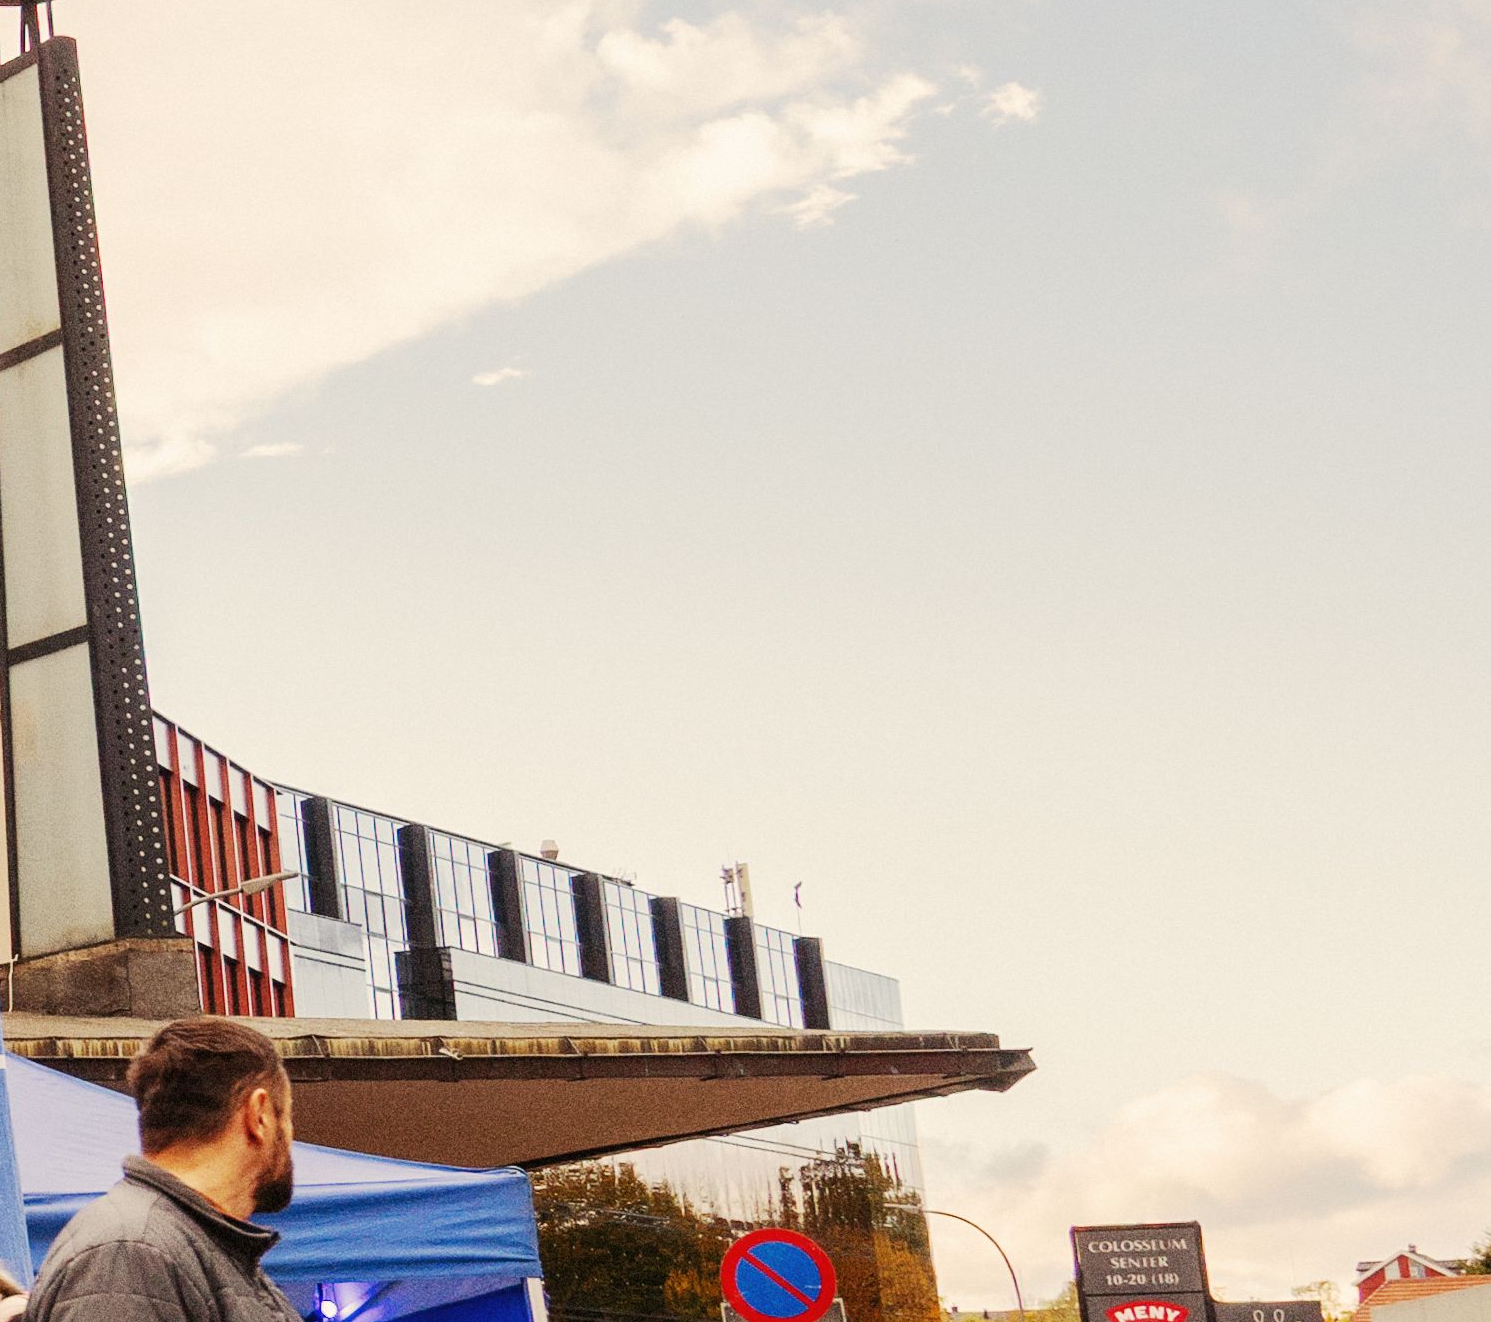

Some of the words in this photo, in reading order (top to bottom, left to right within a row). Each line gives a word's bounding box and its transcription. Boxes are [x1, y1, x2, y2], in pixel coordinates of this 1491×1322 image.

[1088, 1239, 1187, 1254] COLOSSEUM
[1110, 1256, 1169, 1269] SENTER
[1106, 1273, 1146, 1286] 10-20
[1151, 1273, 1180, 1286] (18)
